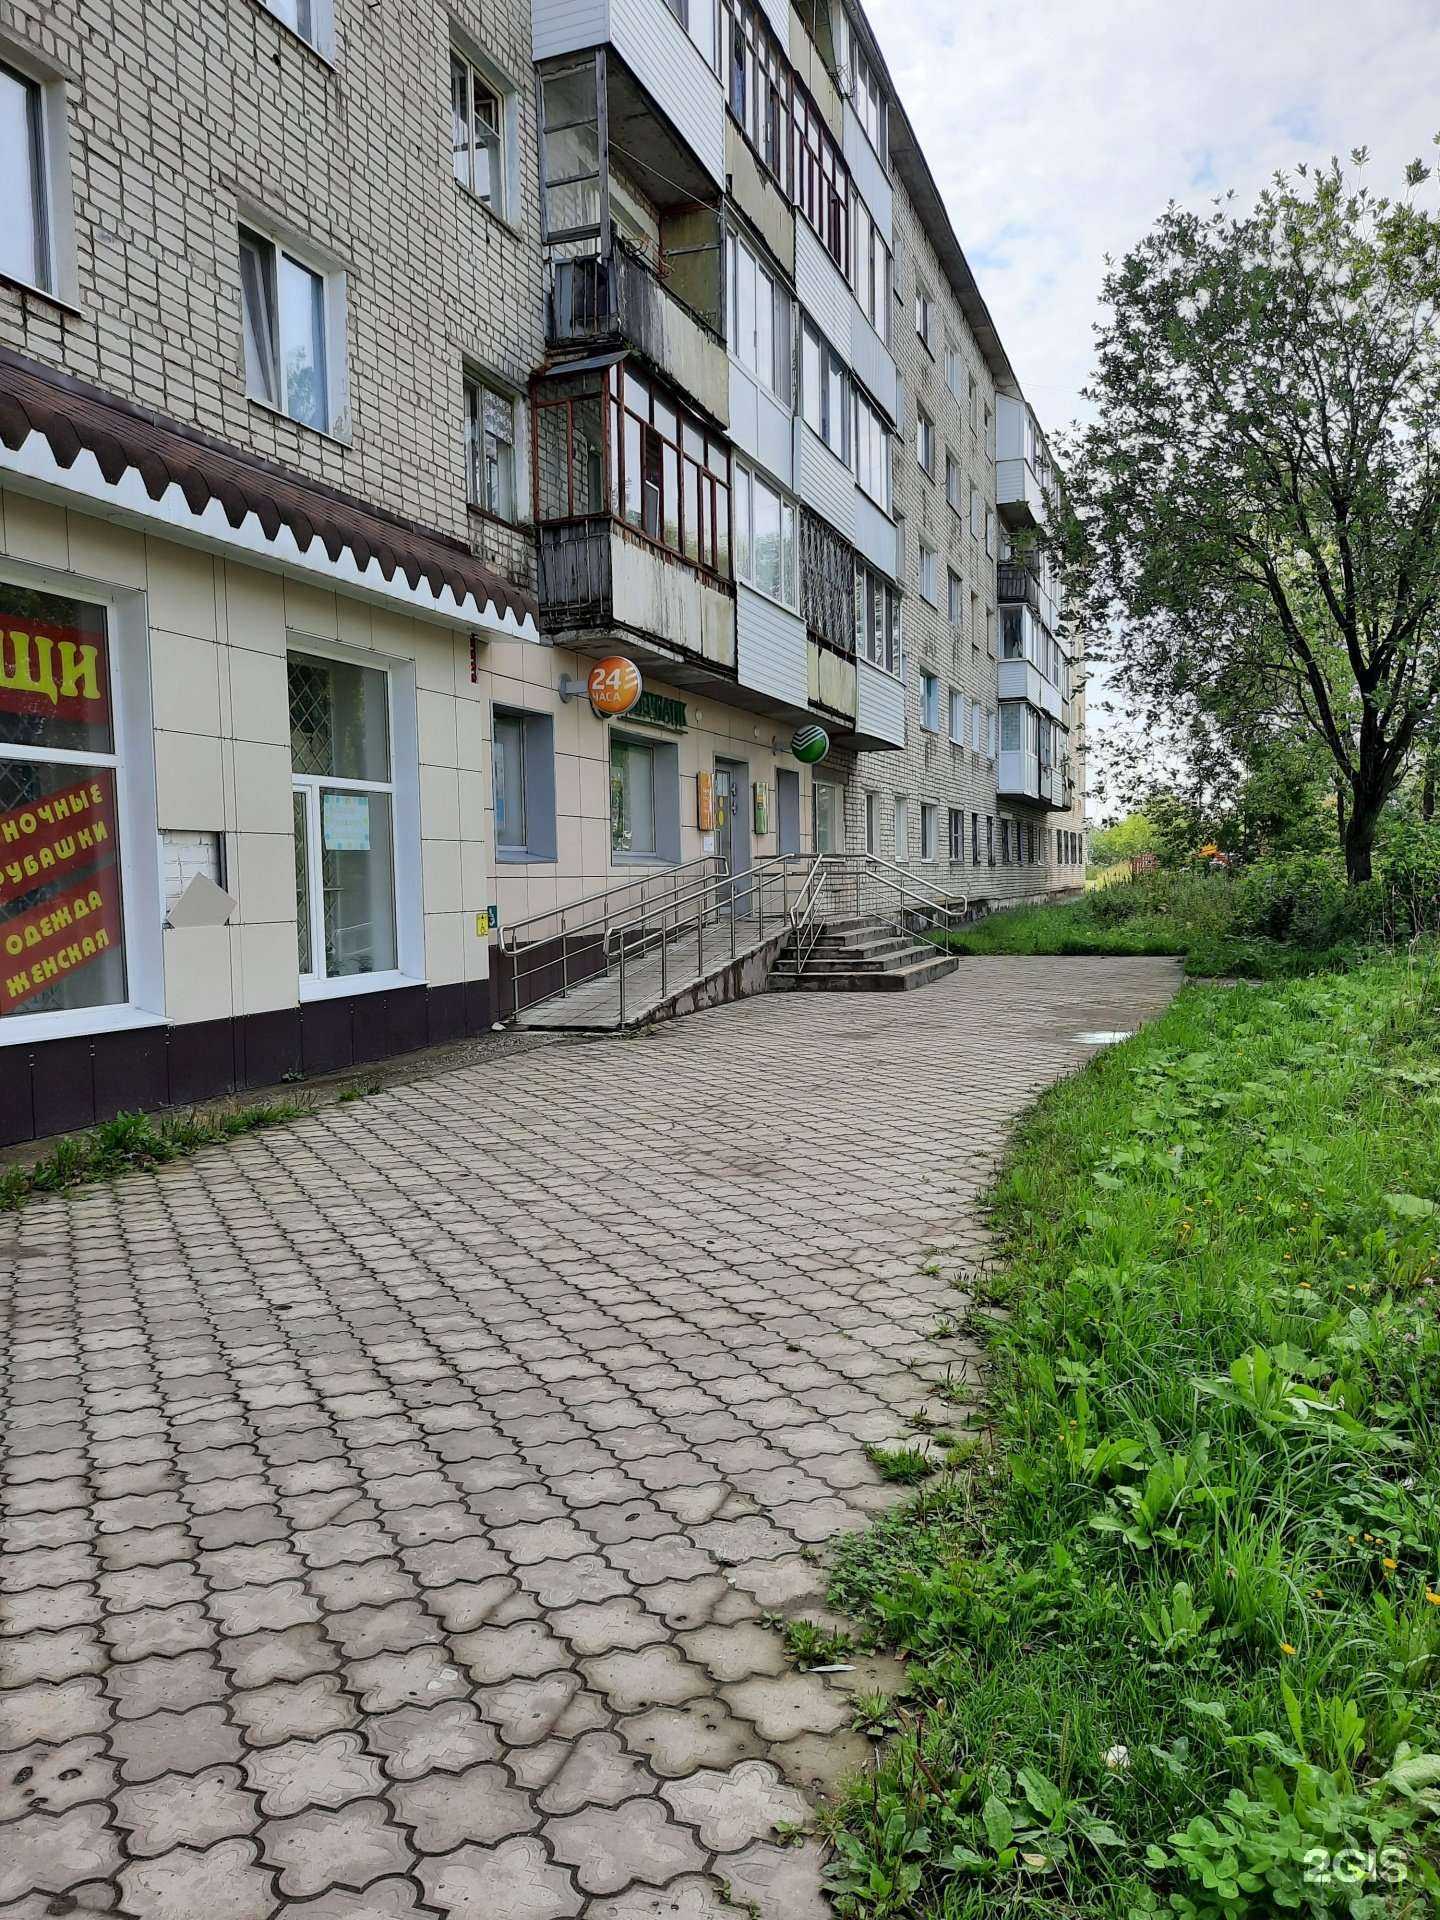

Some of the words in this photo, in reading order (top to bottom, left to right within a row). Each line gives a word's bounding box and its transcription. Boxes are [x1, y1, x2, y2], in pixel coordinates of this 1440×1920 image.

[591, 668, 622, 690] 24
[591, 690, 622, 703] ЧАСА
[1, 784, 104, 843] НОЧНЫЕ
[5, 890, 103, 956] ОДЕЖДА
[5, 928, 110, 999] ЖЕНСКАЯ
